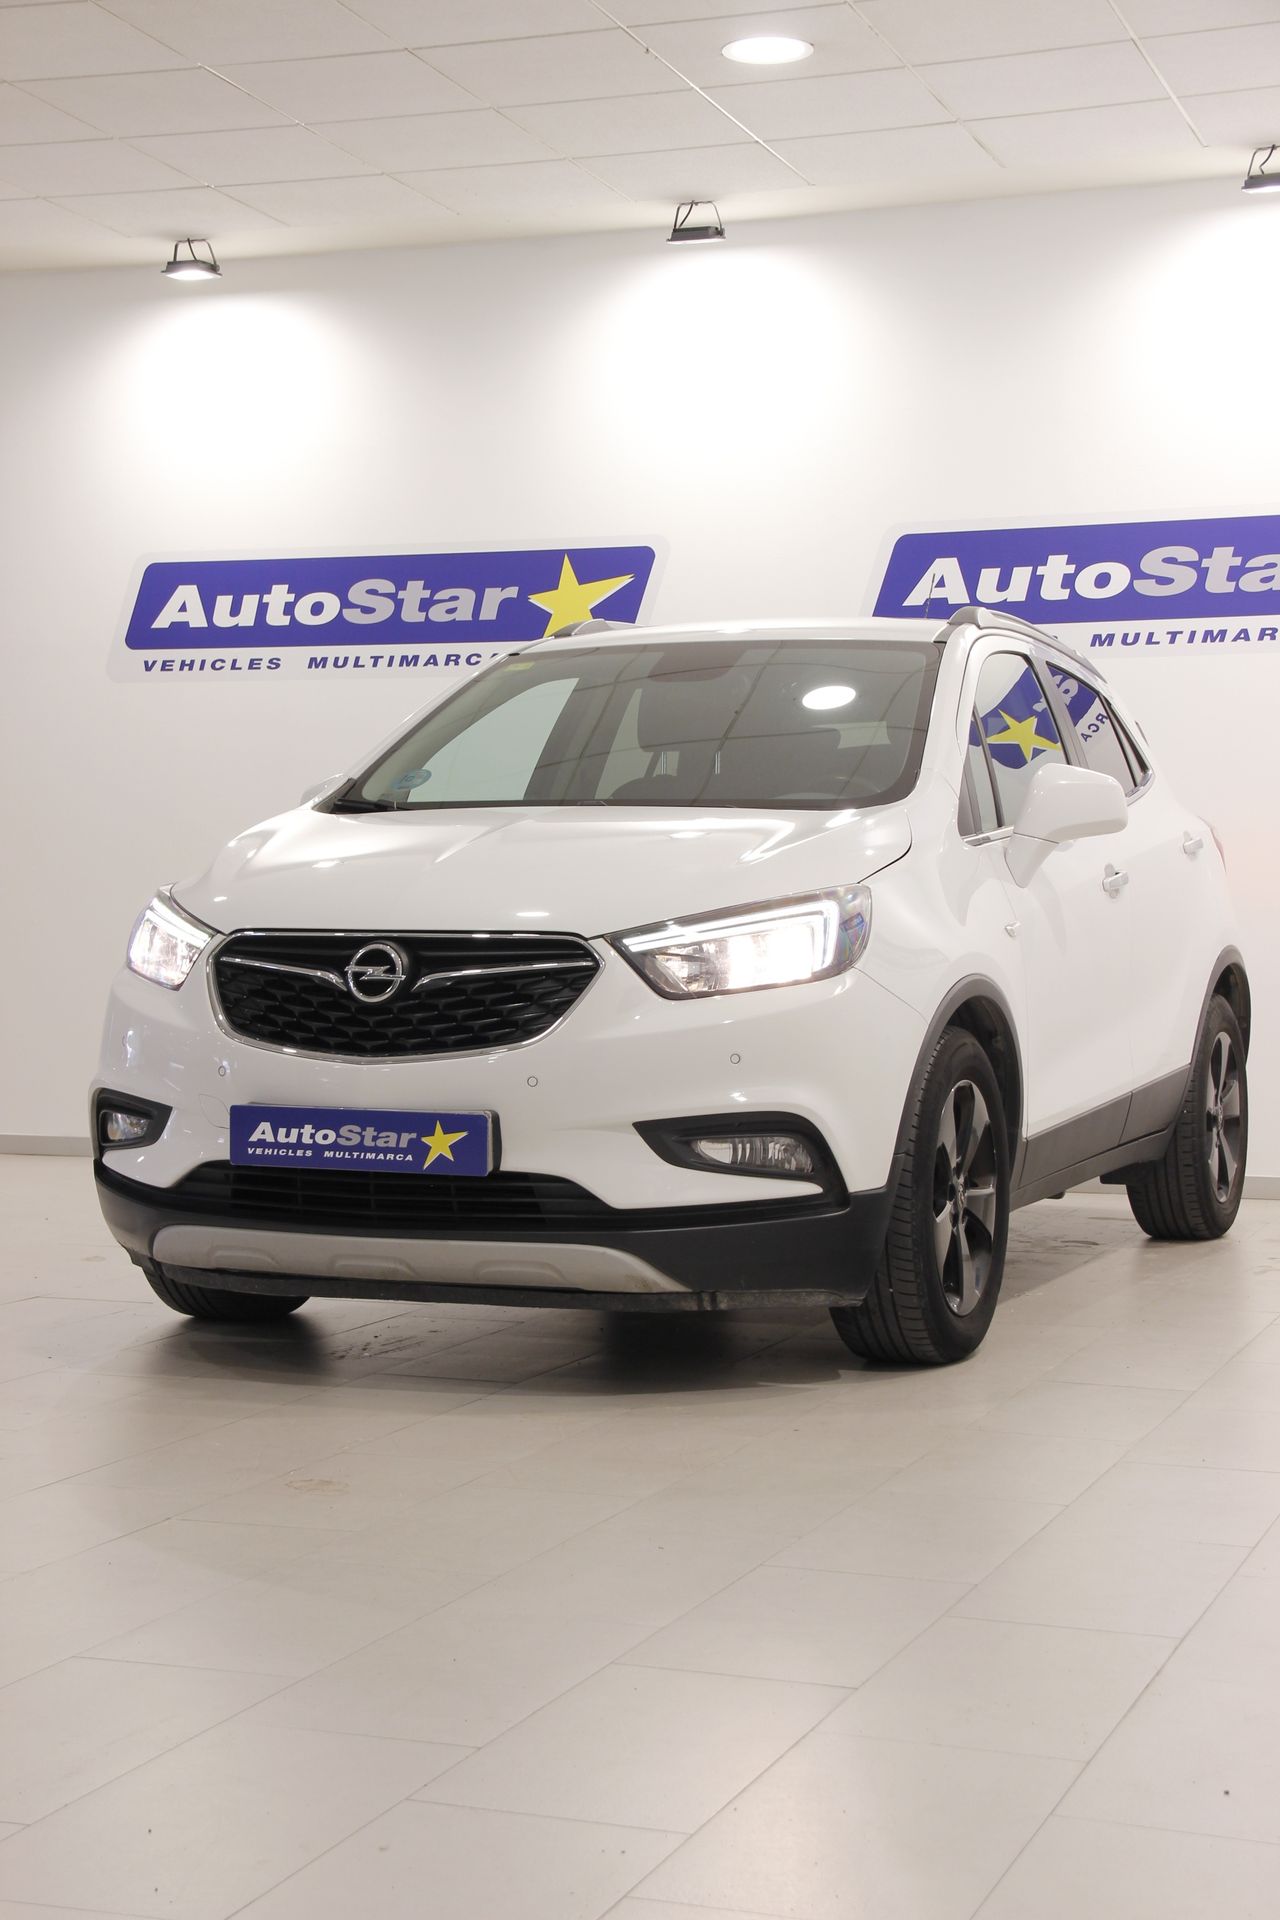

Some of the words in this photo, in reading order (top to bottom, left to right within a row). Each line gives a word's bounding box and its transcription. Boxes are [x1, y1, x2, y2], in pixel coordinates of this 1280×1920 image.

[150, 578, 520, 629] AutoStar
[143, 656, 282, 673] VEHICLES
[307, 652, 499, 670] MULTIMARC
[248, 1121, 417, 1148] AutoStar
[247, 1147, 313, 1157] VEHICLES
[323, 1150, 413, 1162] MULTIMARCA
